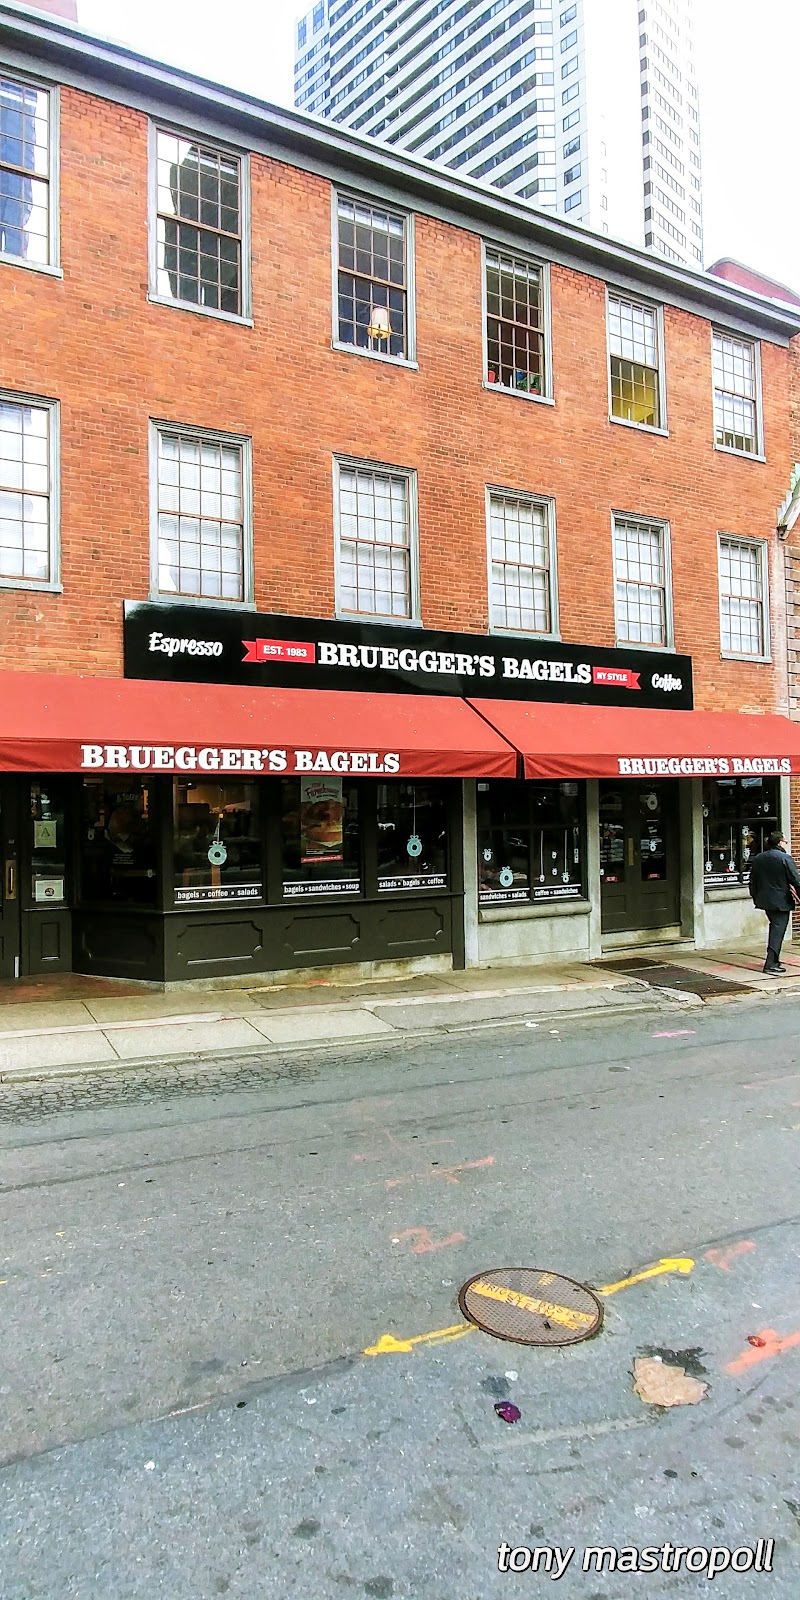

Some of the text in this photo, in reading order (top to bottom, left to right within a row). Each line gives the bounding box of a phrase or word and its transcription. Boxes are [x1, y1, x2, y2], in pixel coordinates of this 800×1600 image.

[149, 632, 223, 657] Espresso
[263, 644, 308, 657] EST. 1983
[318, 642, 591, 684] BRUEGGER'S BAGELS
[596, 671, 627, 682] NY STYLE
[651, 673, 682, 692] Coffee
[80, 744, 400, 773] BRUEGGER'S BAGELS
[618, 758, 792, 775] BRUEGGER'S BAGELS
[284, 883, 360, 894] bagels sandwiches soup
[403, 879, 420, 887] bagels
[177, 888, 258, 900] bagels coffee salads
